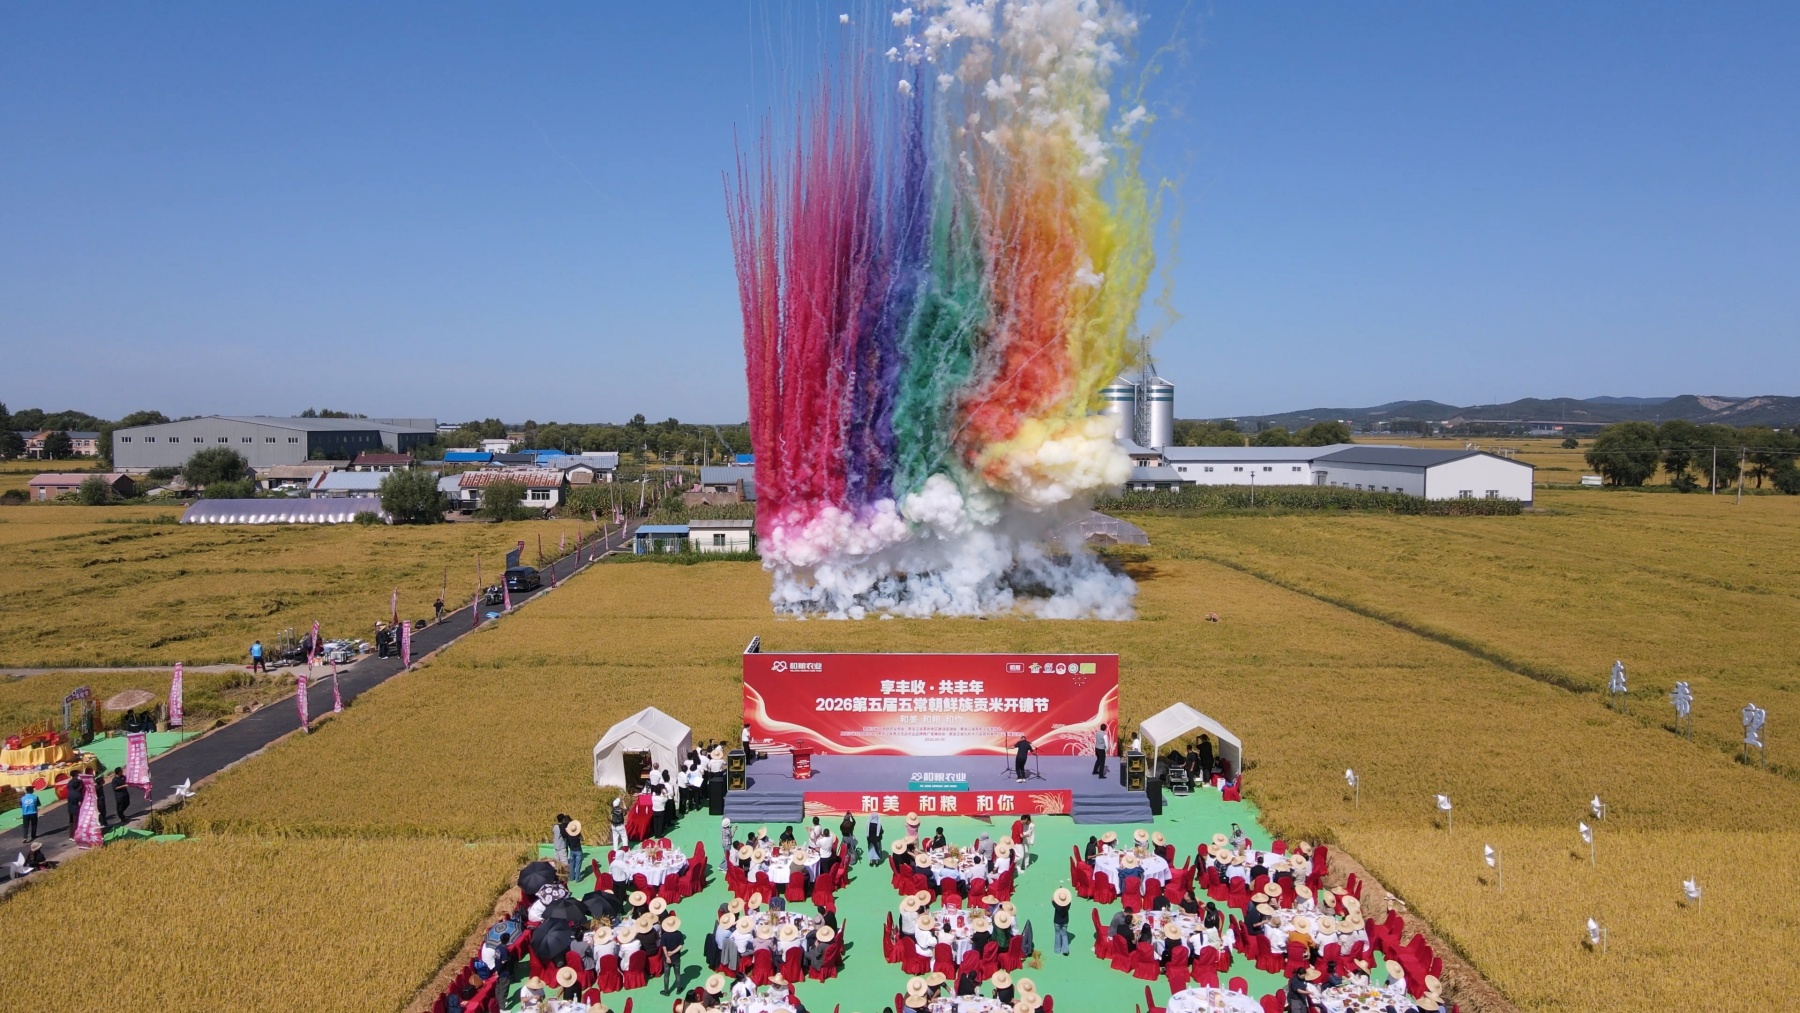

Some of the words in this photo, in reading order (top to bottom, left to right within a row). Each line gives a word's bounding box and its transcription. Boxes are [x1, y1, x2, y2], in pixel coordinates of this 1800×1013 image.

[861, 795, 900, 813] 和美
[919, 795, 957, 813] 和粮
[976, 794, 1015, 812] 和你
